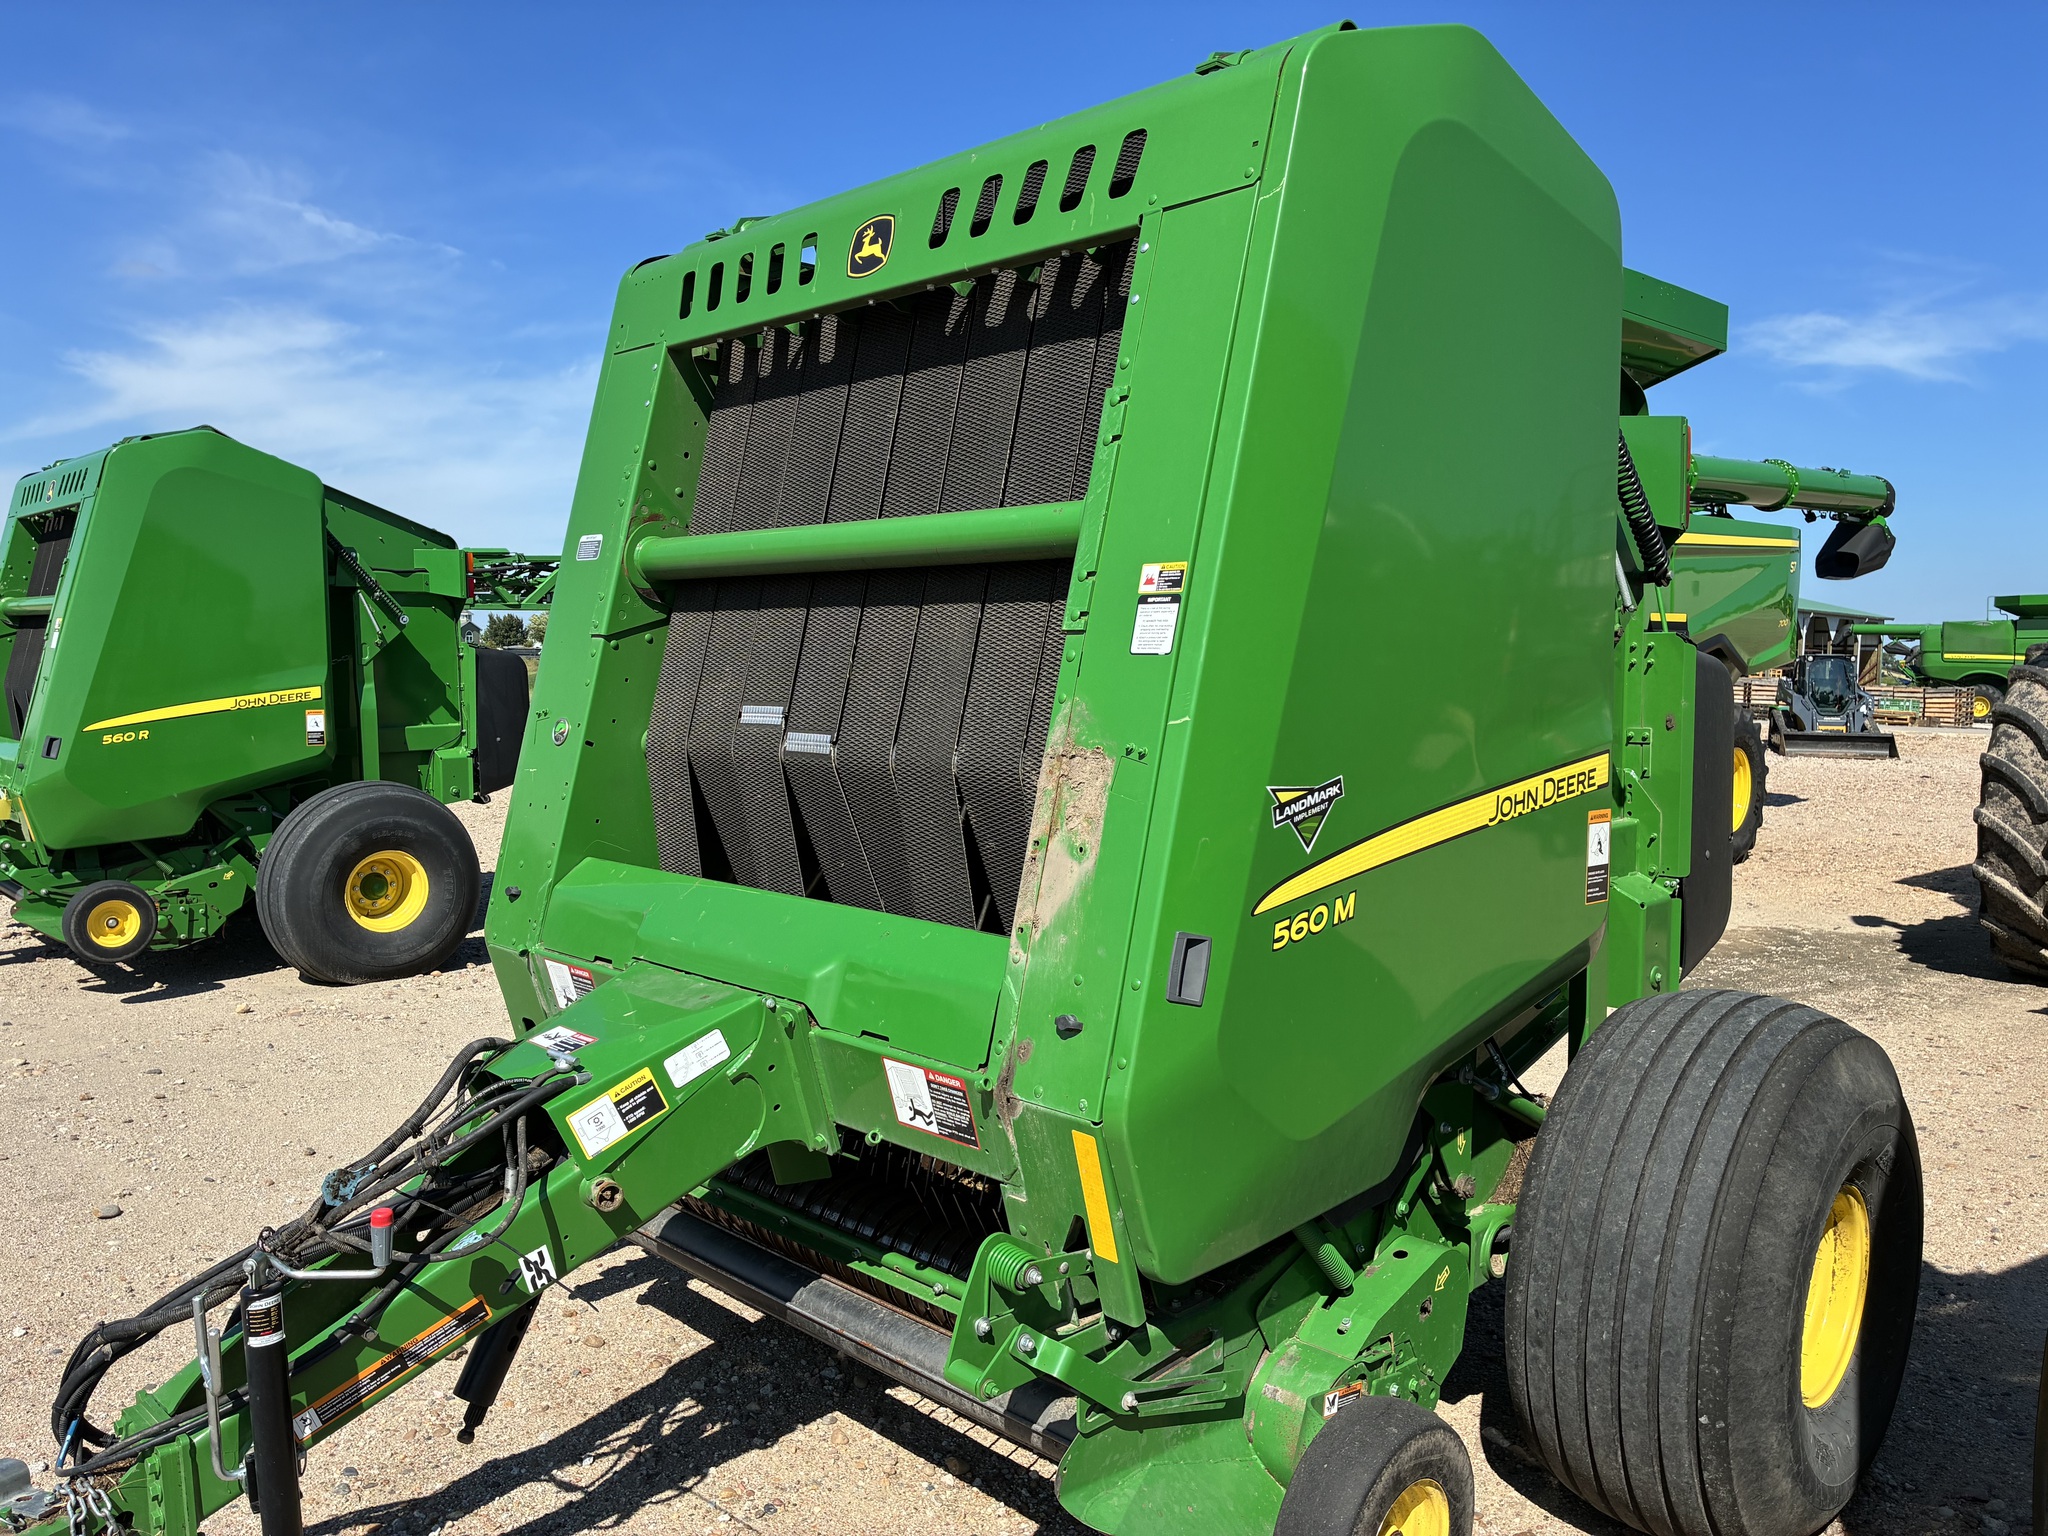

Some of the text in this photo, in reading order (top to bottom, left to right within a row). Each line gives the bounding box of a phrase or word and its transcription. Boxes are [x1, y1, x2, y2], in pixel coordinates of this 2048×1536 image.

[230, 691, 311, 709] JOHN DEERE
[102, 730, 150, 745] 560 R
[1488, 768, 1597, 823] JOHN DEERE
[1294, 802, 1329, 822] IMPLEMENT
[1272, 890, 1357, 952] 560 M
[620, 1075, 646, 1093] CAUTION
[935, 1074, 961, 1088] DANGER
[385, 1338, 418, 1360] WARNING
